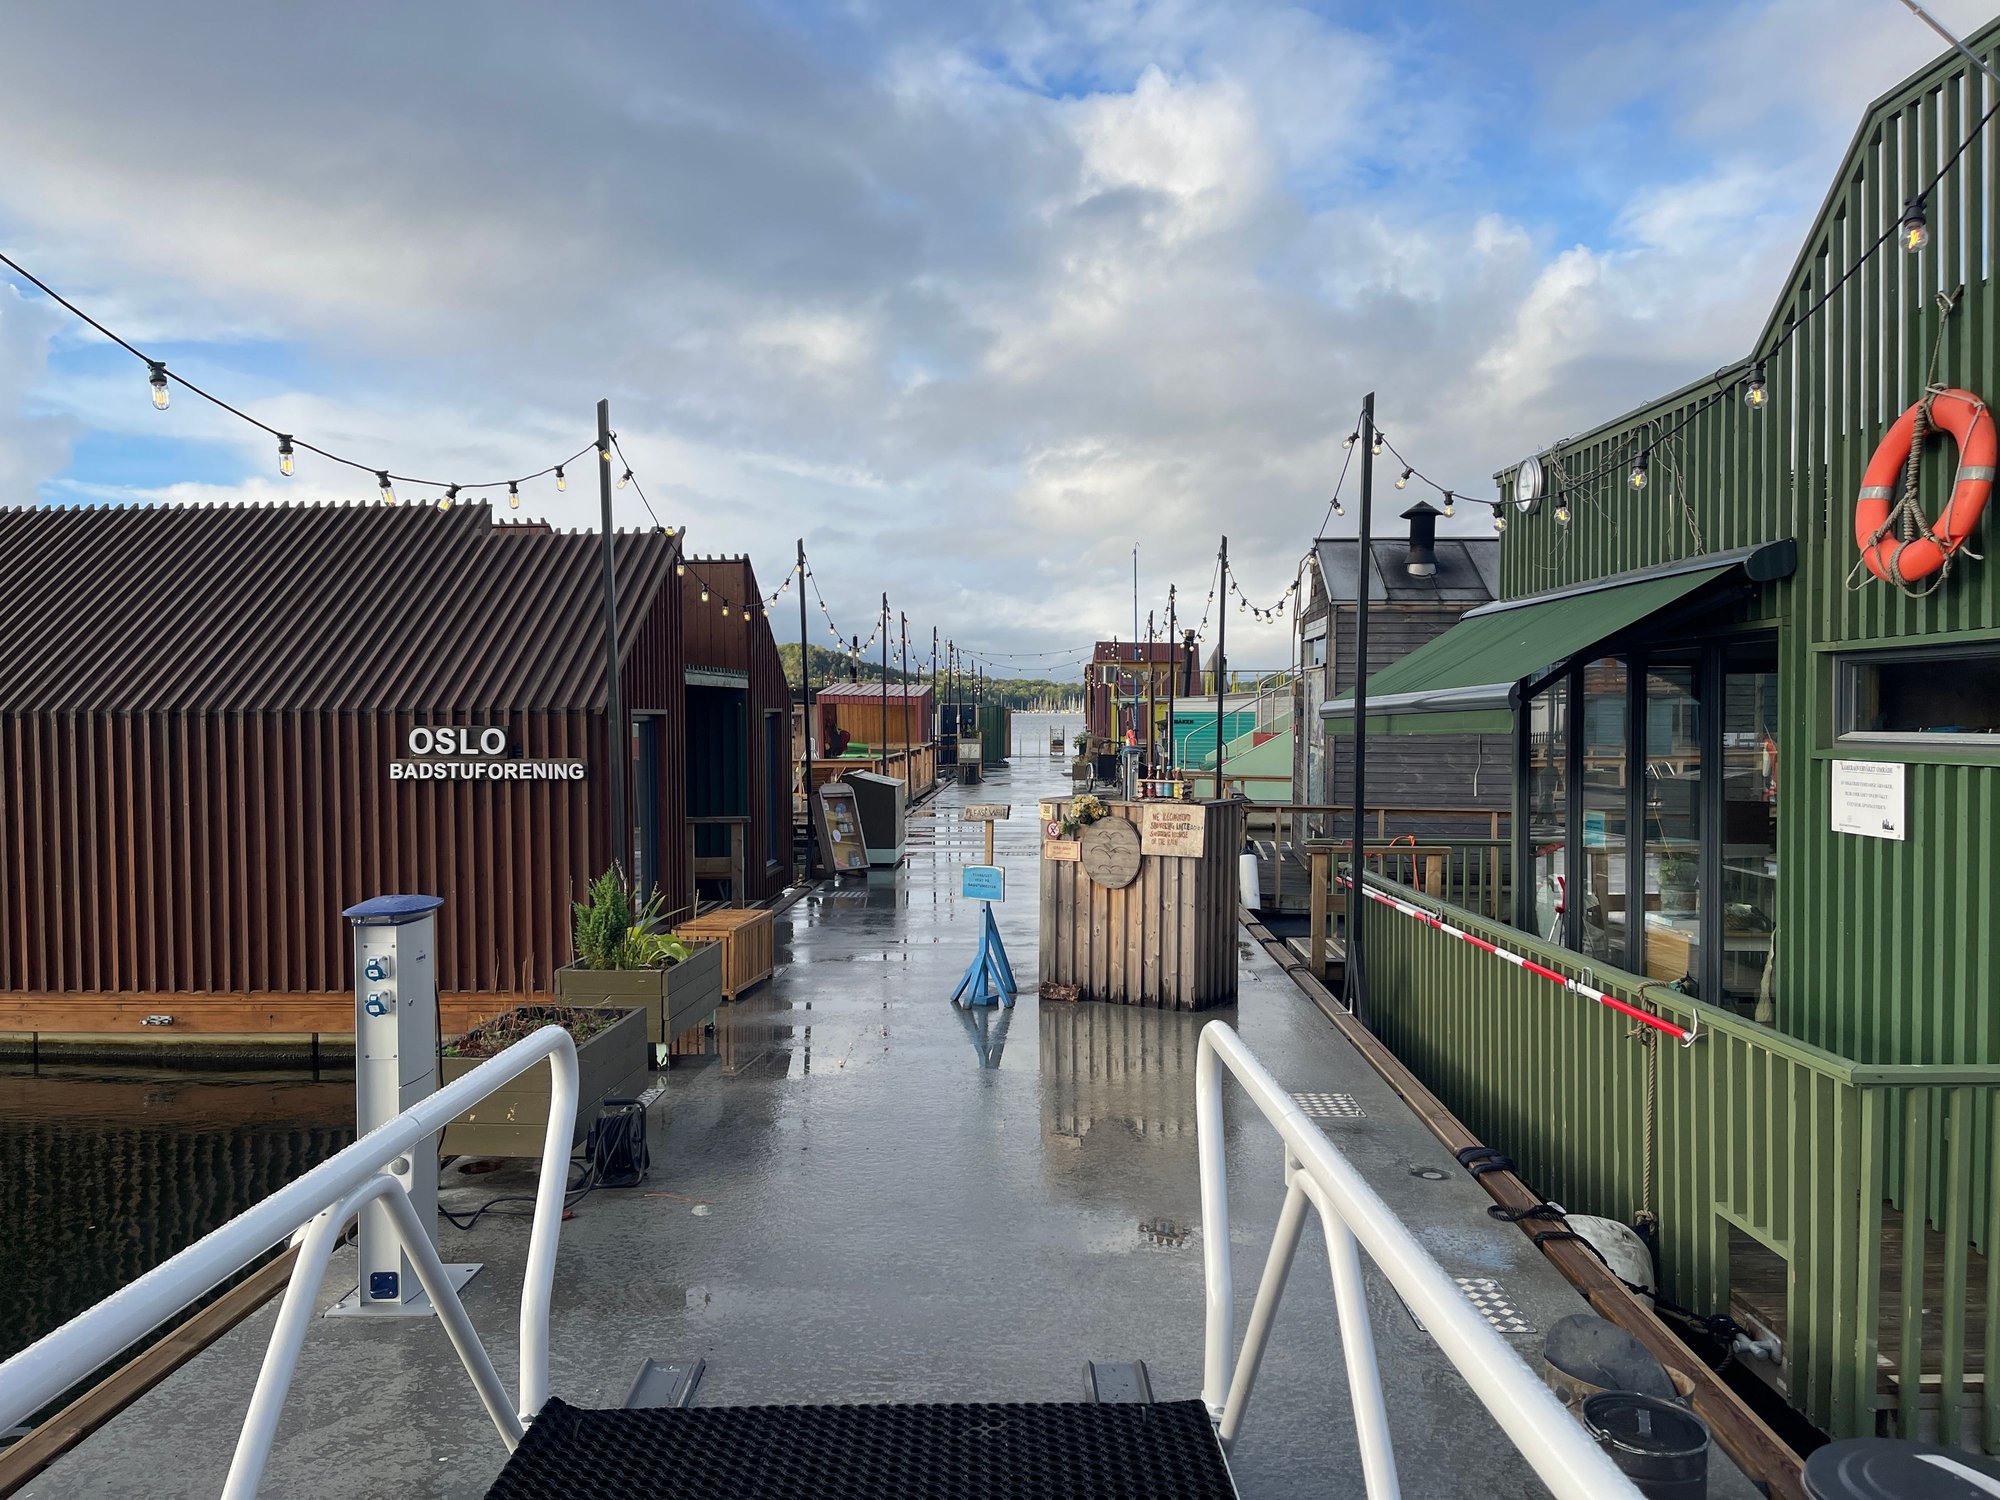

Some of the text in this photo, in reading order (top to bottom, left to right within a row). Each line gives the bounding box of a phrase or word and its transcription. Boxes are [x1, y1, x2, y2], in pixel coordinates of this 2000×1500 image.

[408, 727, 506, 755] OSLO
[389, 762, 585, 780] BADSTUFORENING
[966, 807, 1006, 818] PLEASE WAIT
